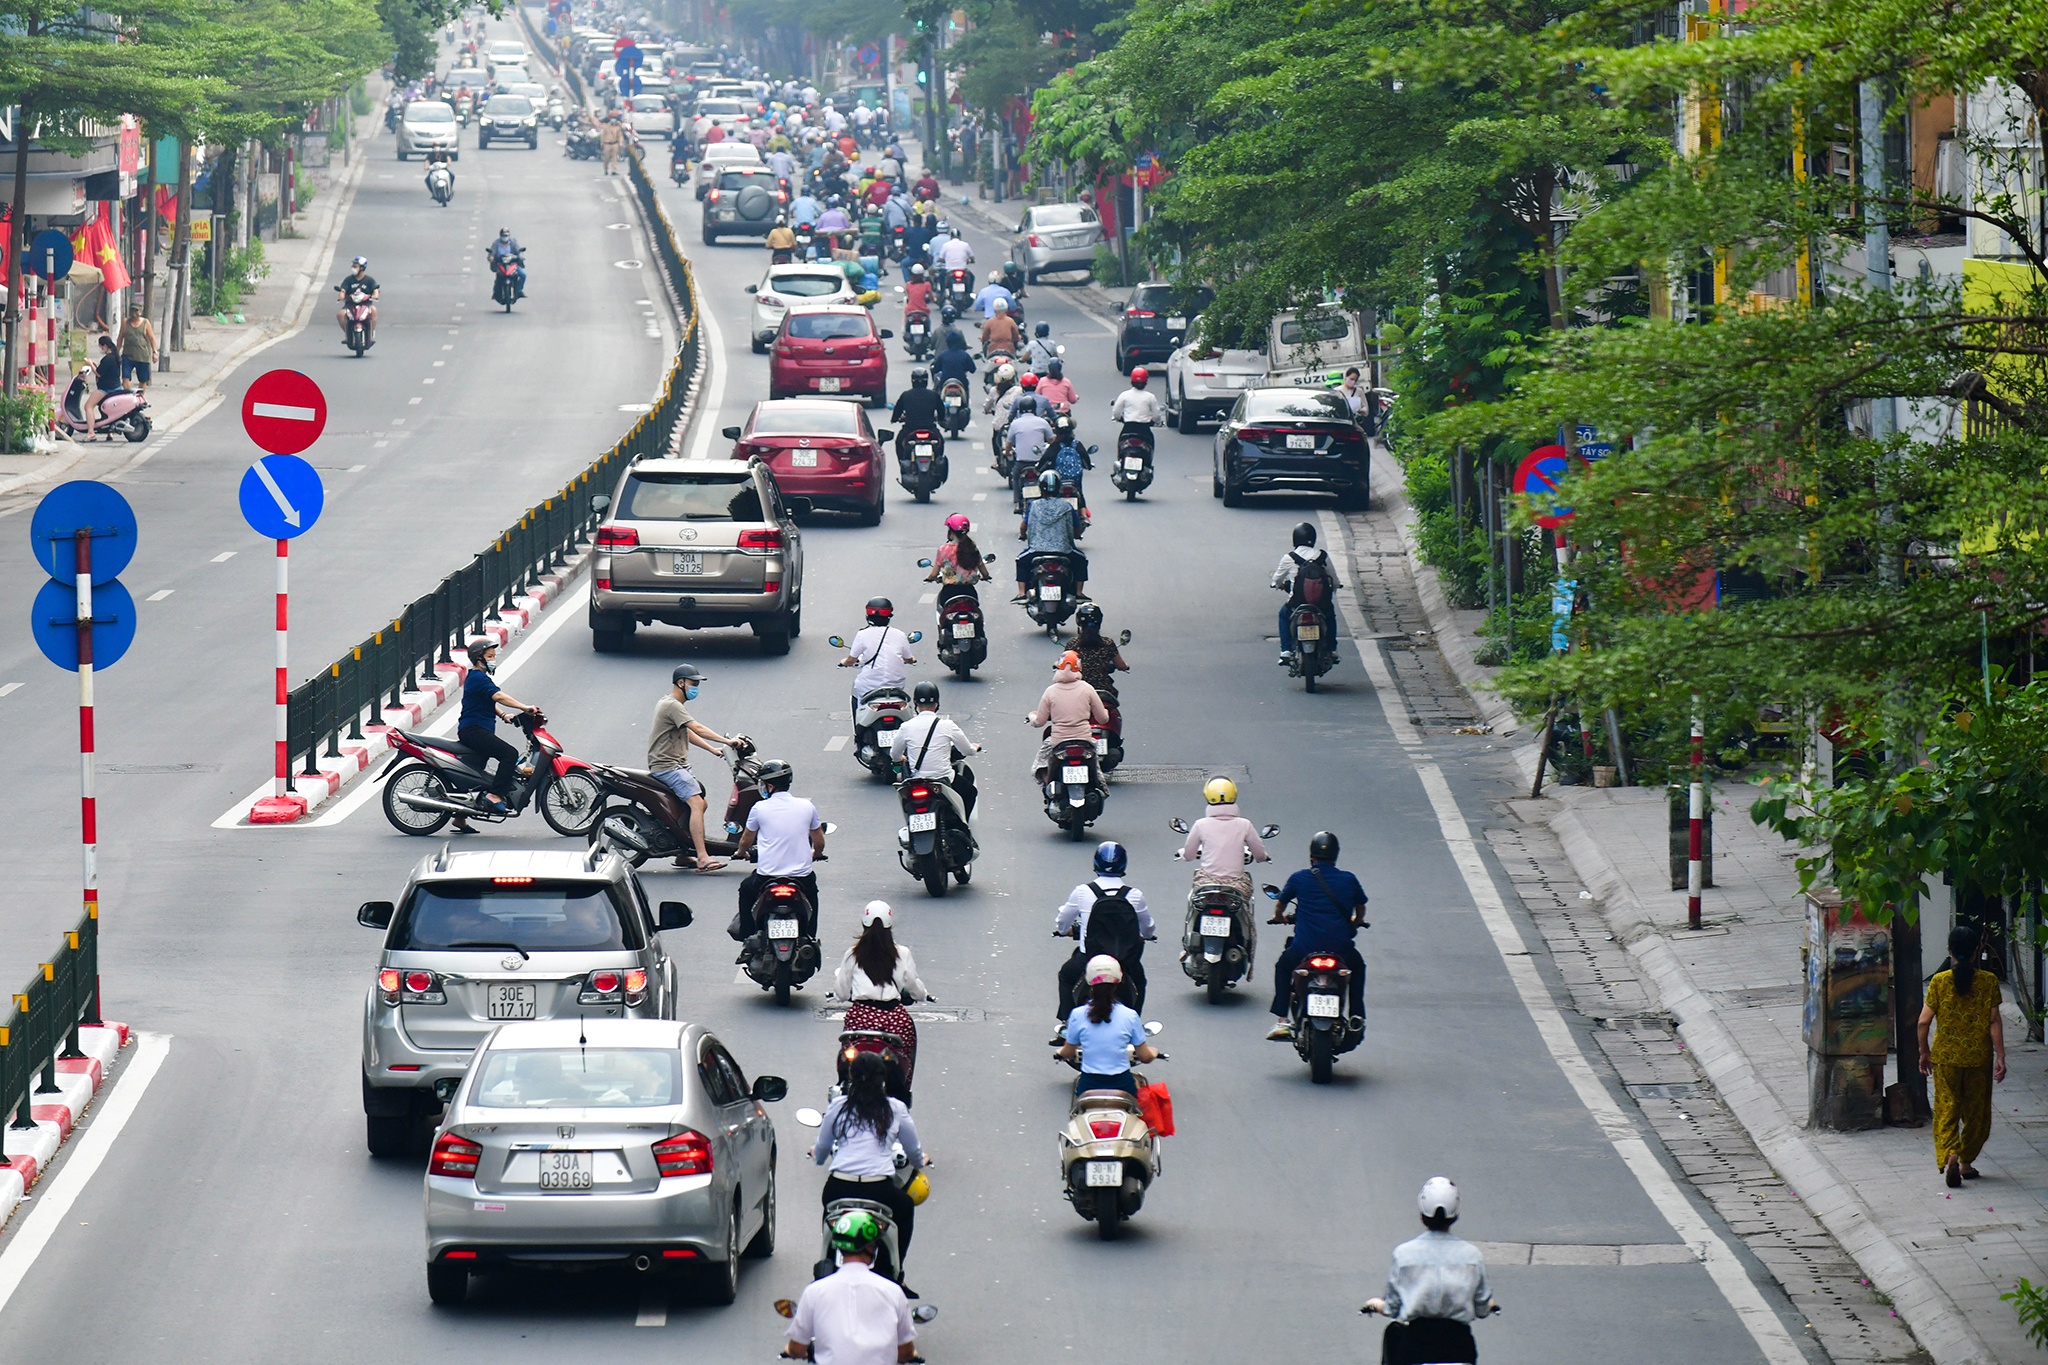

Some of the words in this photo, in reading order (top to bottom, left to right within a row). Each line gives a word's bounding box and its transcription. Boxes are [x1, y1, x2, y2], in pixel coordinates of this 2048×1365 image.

[1294, 374, 1329, 385] SUZU
[1581, 446, 1596, 456] TÂY
[681, 553, 696, 563] 30A
[674, 563, 702, 574] 991.25
[771, 928, 796, 938] 651.02
[500, 987, 524, 1001] 30E
[491, 1002, 534, 1018] 117.17
[552, 1154, 580, 1170] 30A
[541, 1171, 591, 1188] 039.69
[1092, 1174, 1117, 1185] 5934
